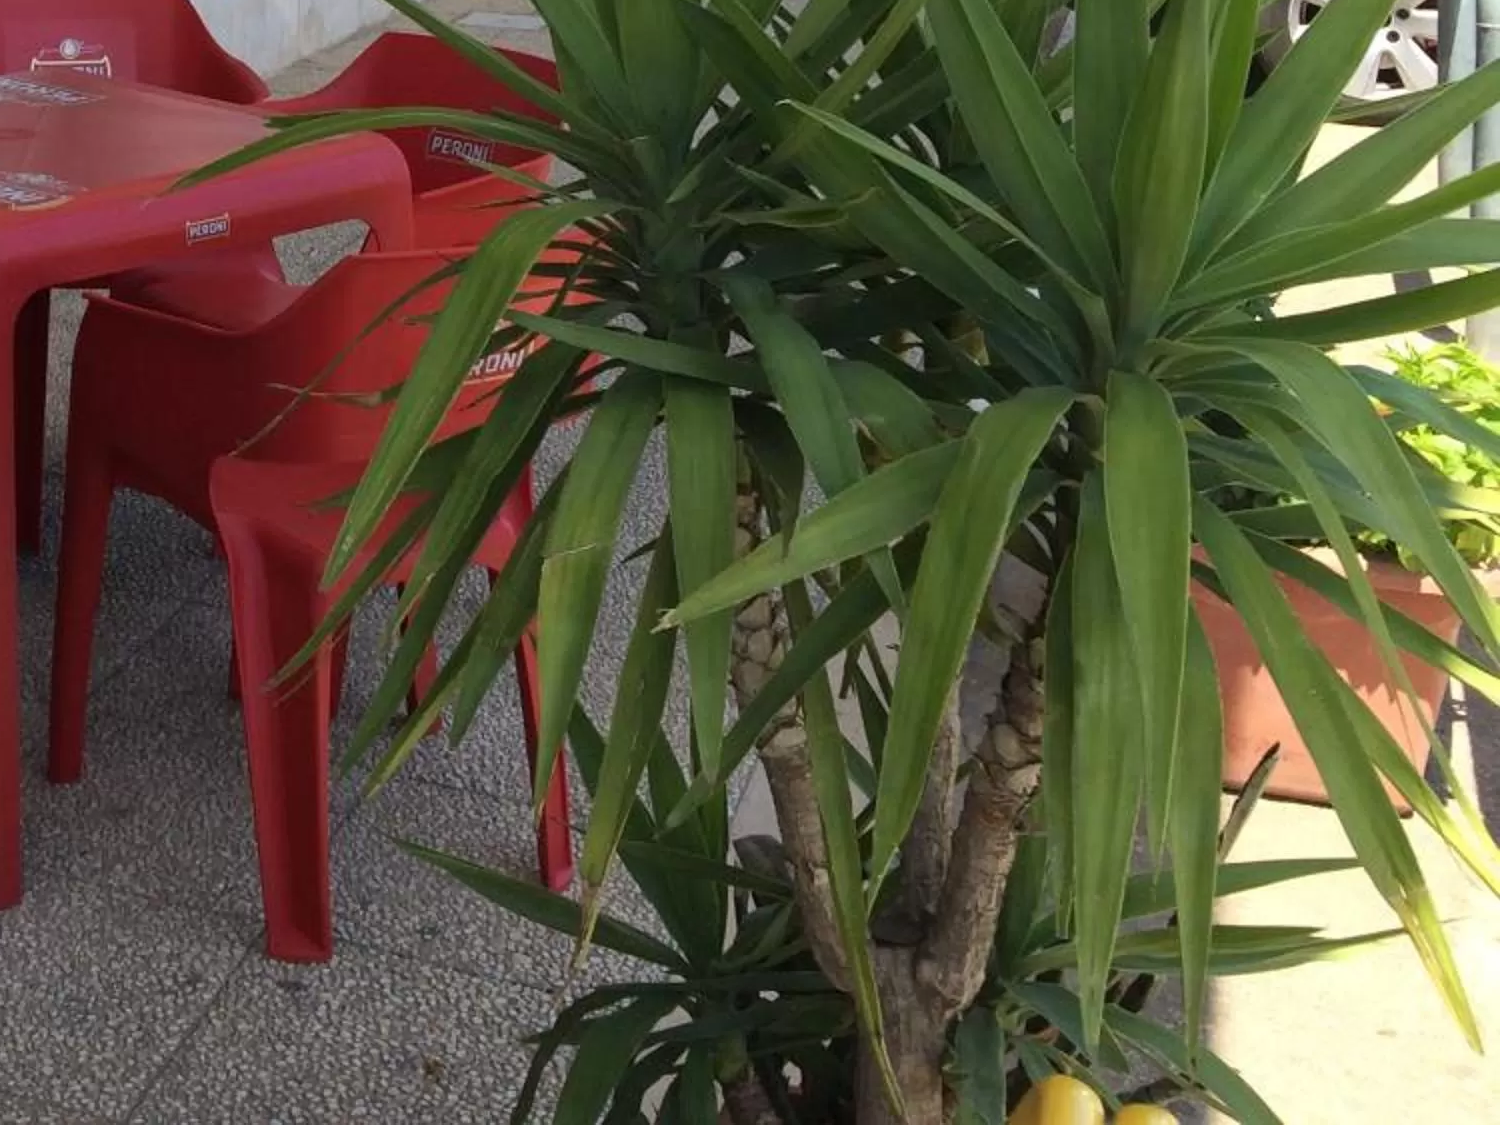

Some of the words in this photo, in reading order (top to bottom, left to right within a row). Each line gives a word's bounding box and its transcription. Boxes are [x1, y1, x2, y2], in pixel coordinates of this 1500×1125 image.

[430, 136, 490, 164] PERONI
[189, 221, 227, 238] PERONI
[468, 349, 525, 376] RONI
